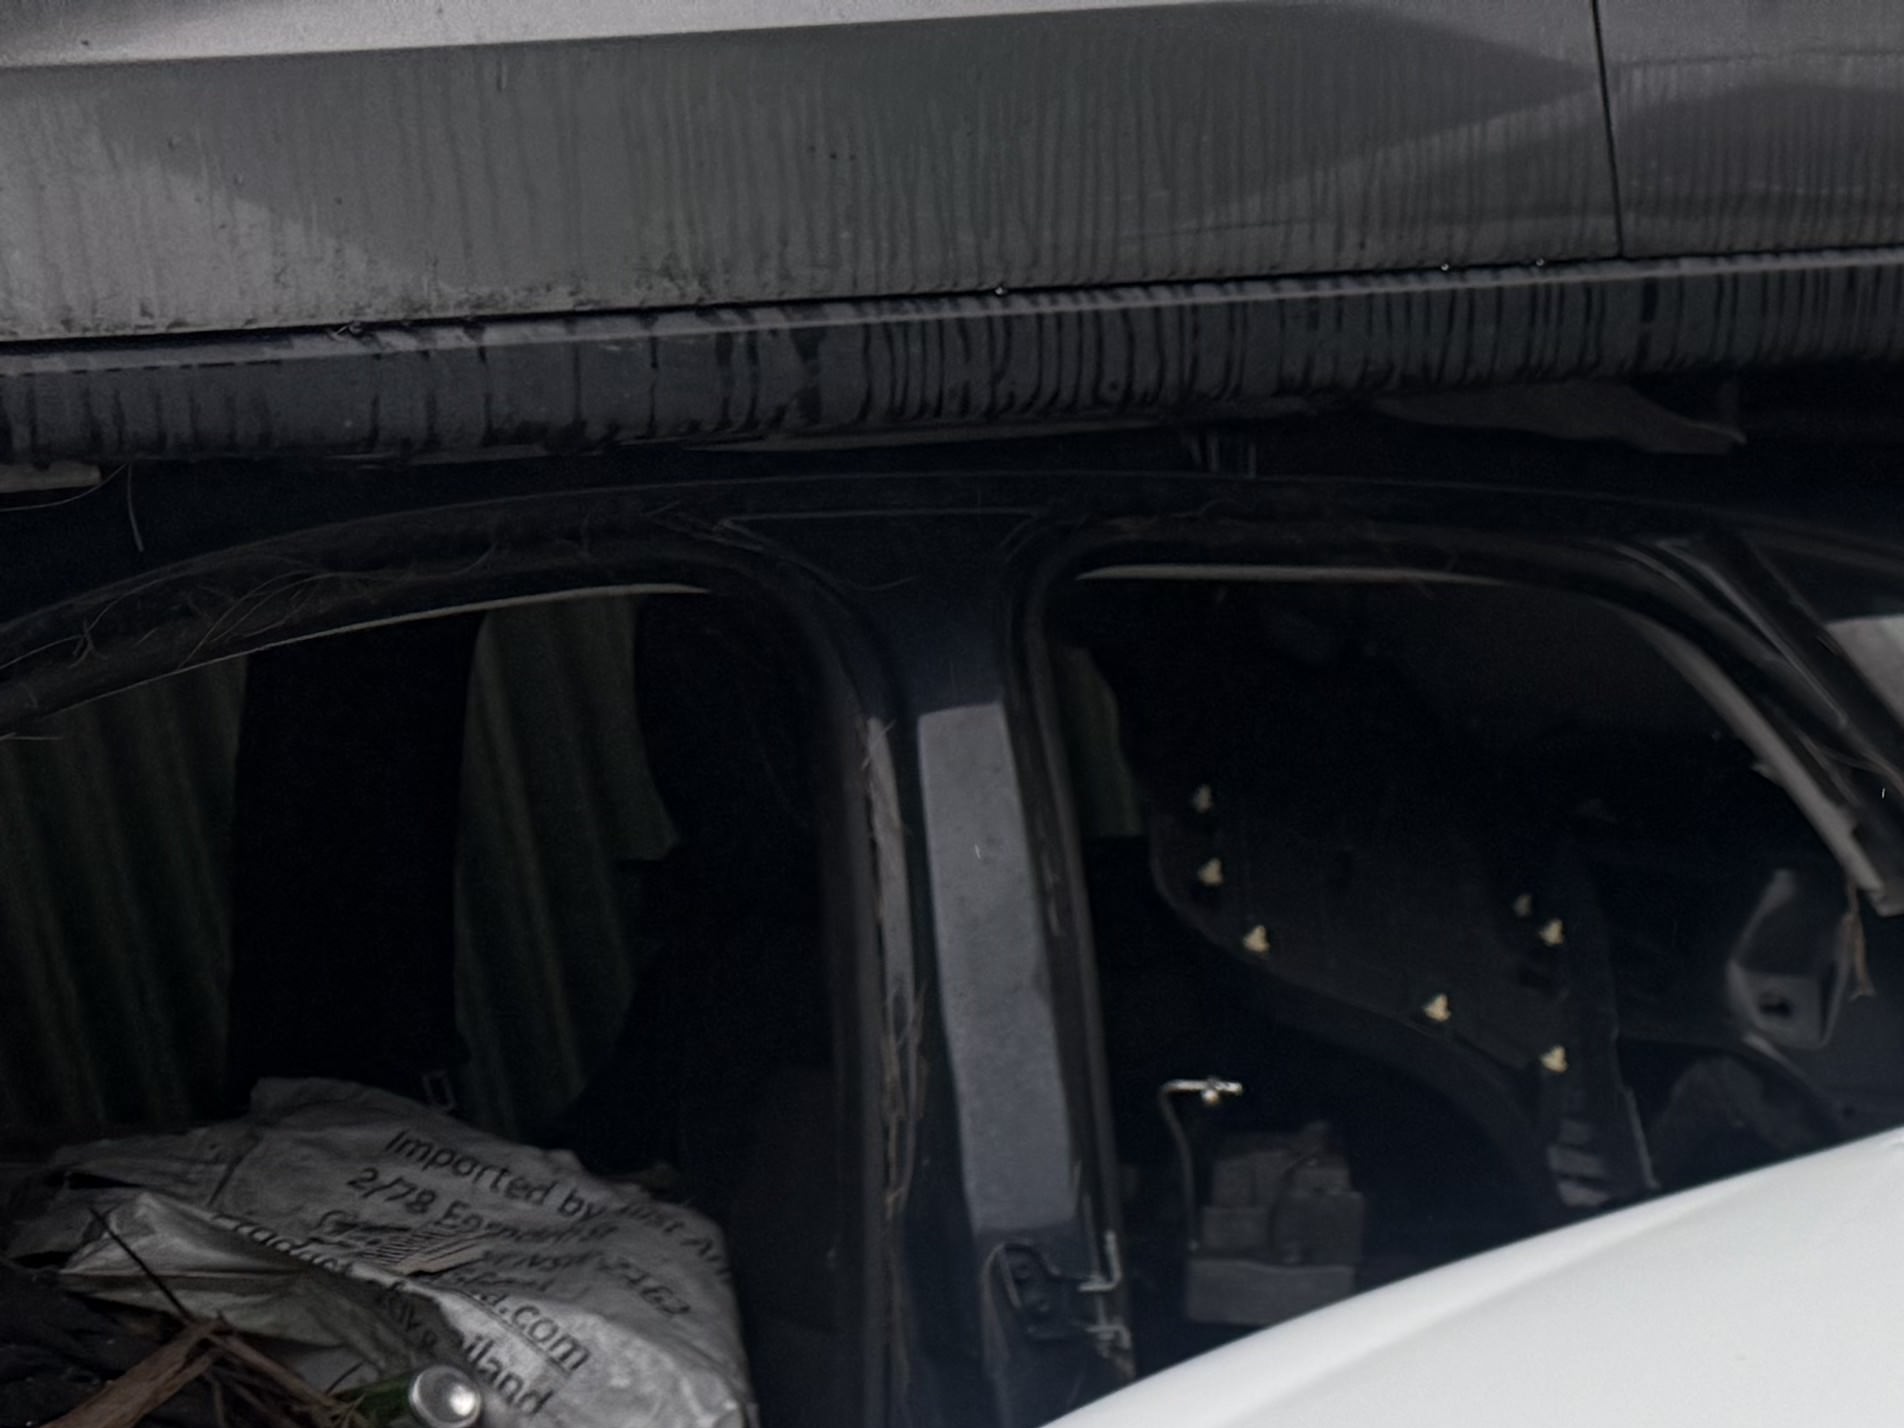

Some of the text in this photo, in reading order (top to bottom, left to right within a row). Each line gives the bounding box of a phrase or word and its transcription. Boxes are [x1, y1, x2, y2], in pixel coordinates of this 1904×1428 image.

[346, 1167, 437, 1216] 2/78
[385, 1129, 557, 1208] Imported
[558, 1184, 608, 1223] by
